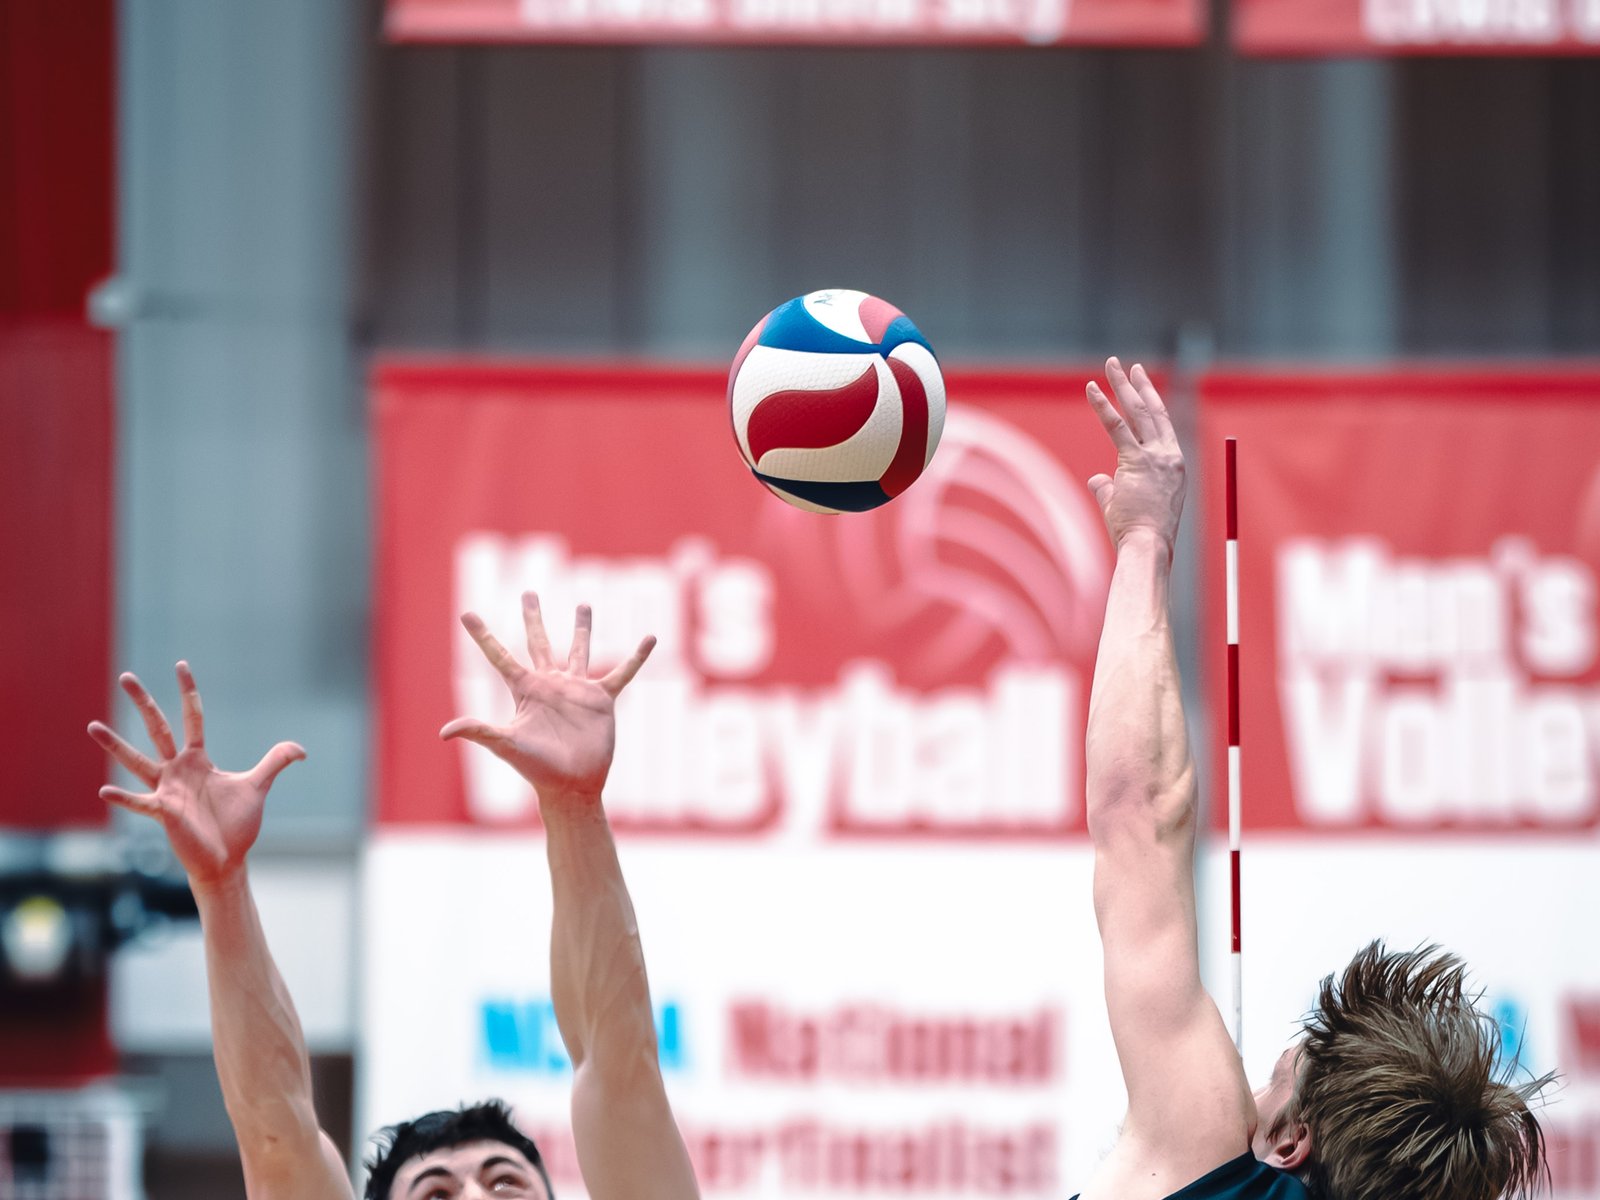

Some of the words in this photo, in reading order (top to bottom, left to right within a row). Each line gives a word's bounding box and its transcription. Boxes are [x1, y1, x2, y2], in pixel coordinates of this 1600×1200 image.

[1276, 535, 1597, 677] Men's
[455, 659, 1080, 844] Vlleyball
[1280, 668, 1600, 823] Volle
